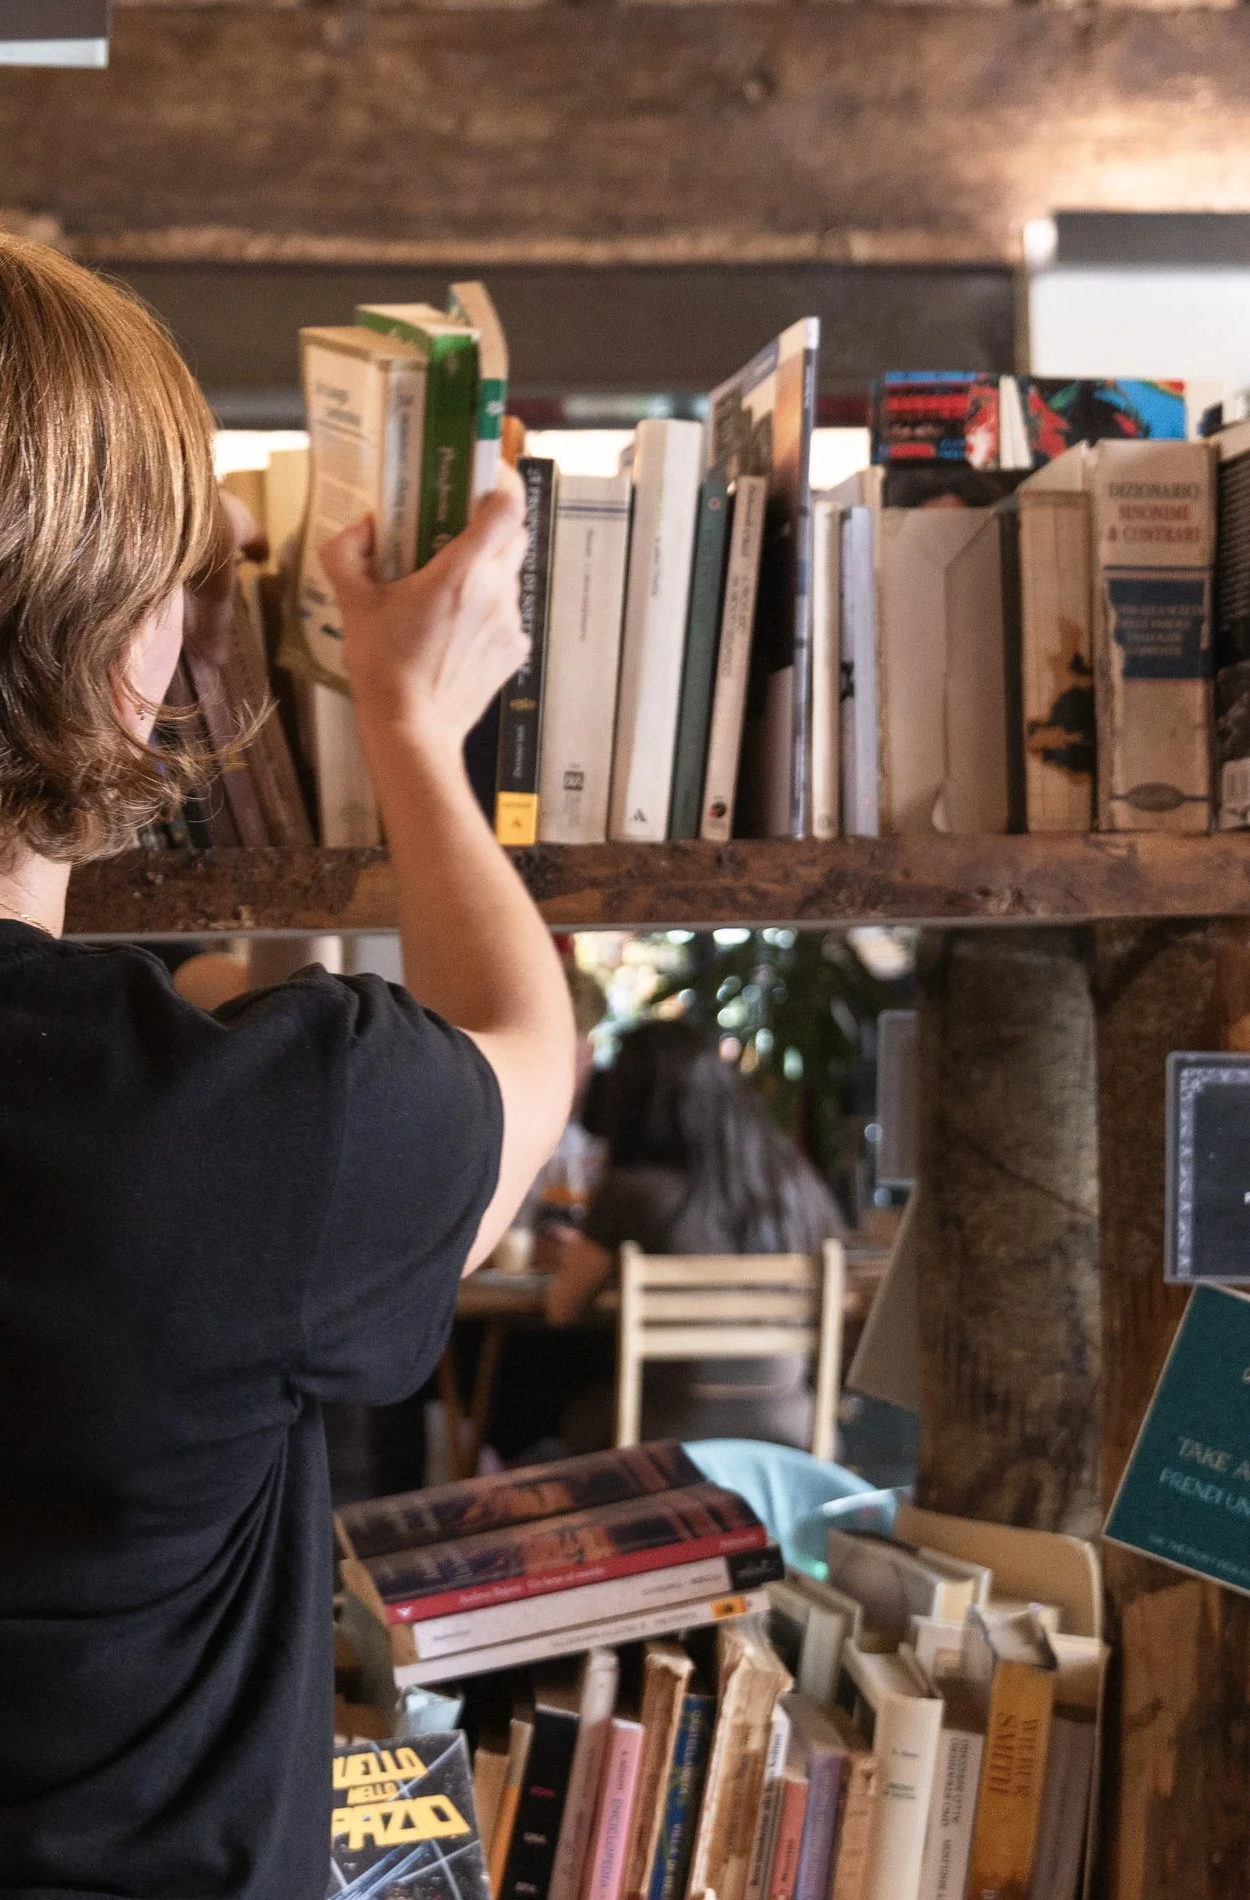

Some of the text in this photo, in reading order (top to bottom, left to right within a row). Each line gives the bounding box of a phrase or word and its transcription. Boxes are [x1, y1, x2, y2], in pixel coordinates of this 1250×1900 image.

[1107, 482, 1201, 499] DIZIONARIO
[1118, 503, 1190, 520] SINONIMI
[1122, 525, 1201, 544] CONTRARI
[1179, 1435, 1232, 1473] TAKE
[1158, 1467, 1224, 1505] PRENDI
[346, 1781, 399, 1806] NELLO
[331, 1793, 471, 1850] PAZIO
